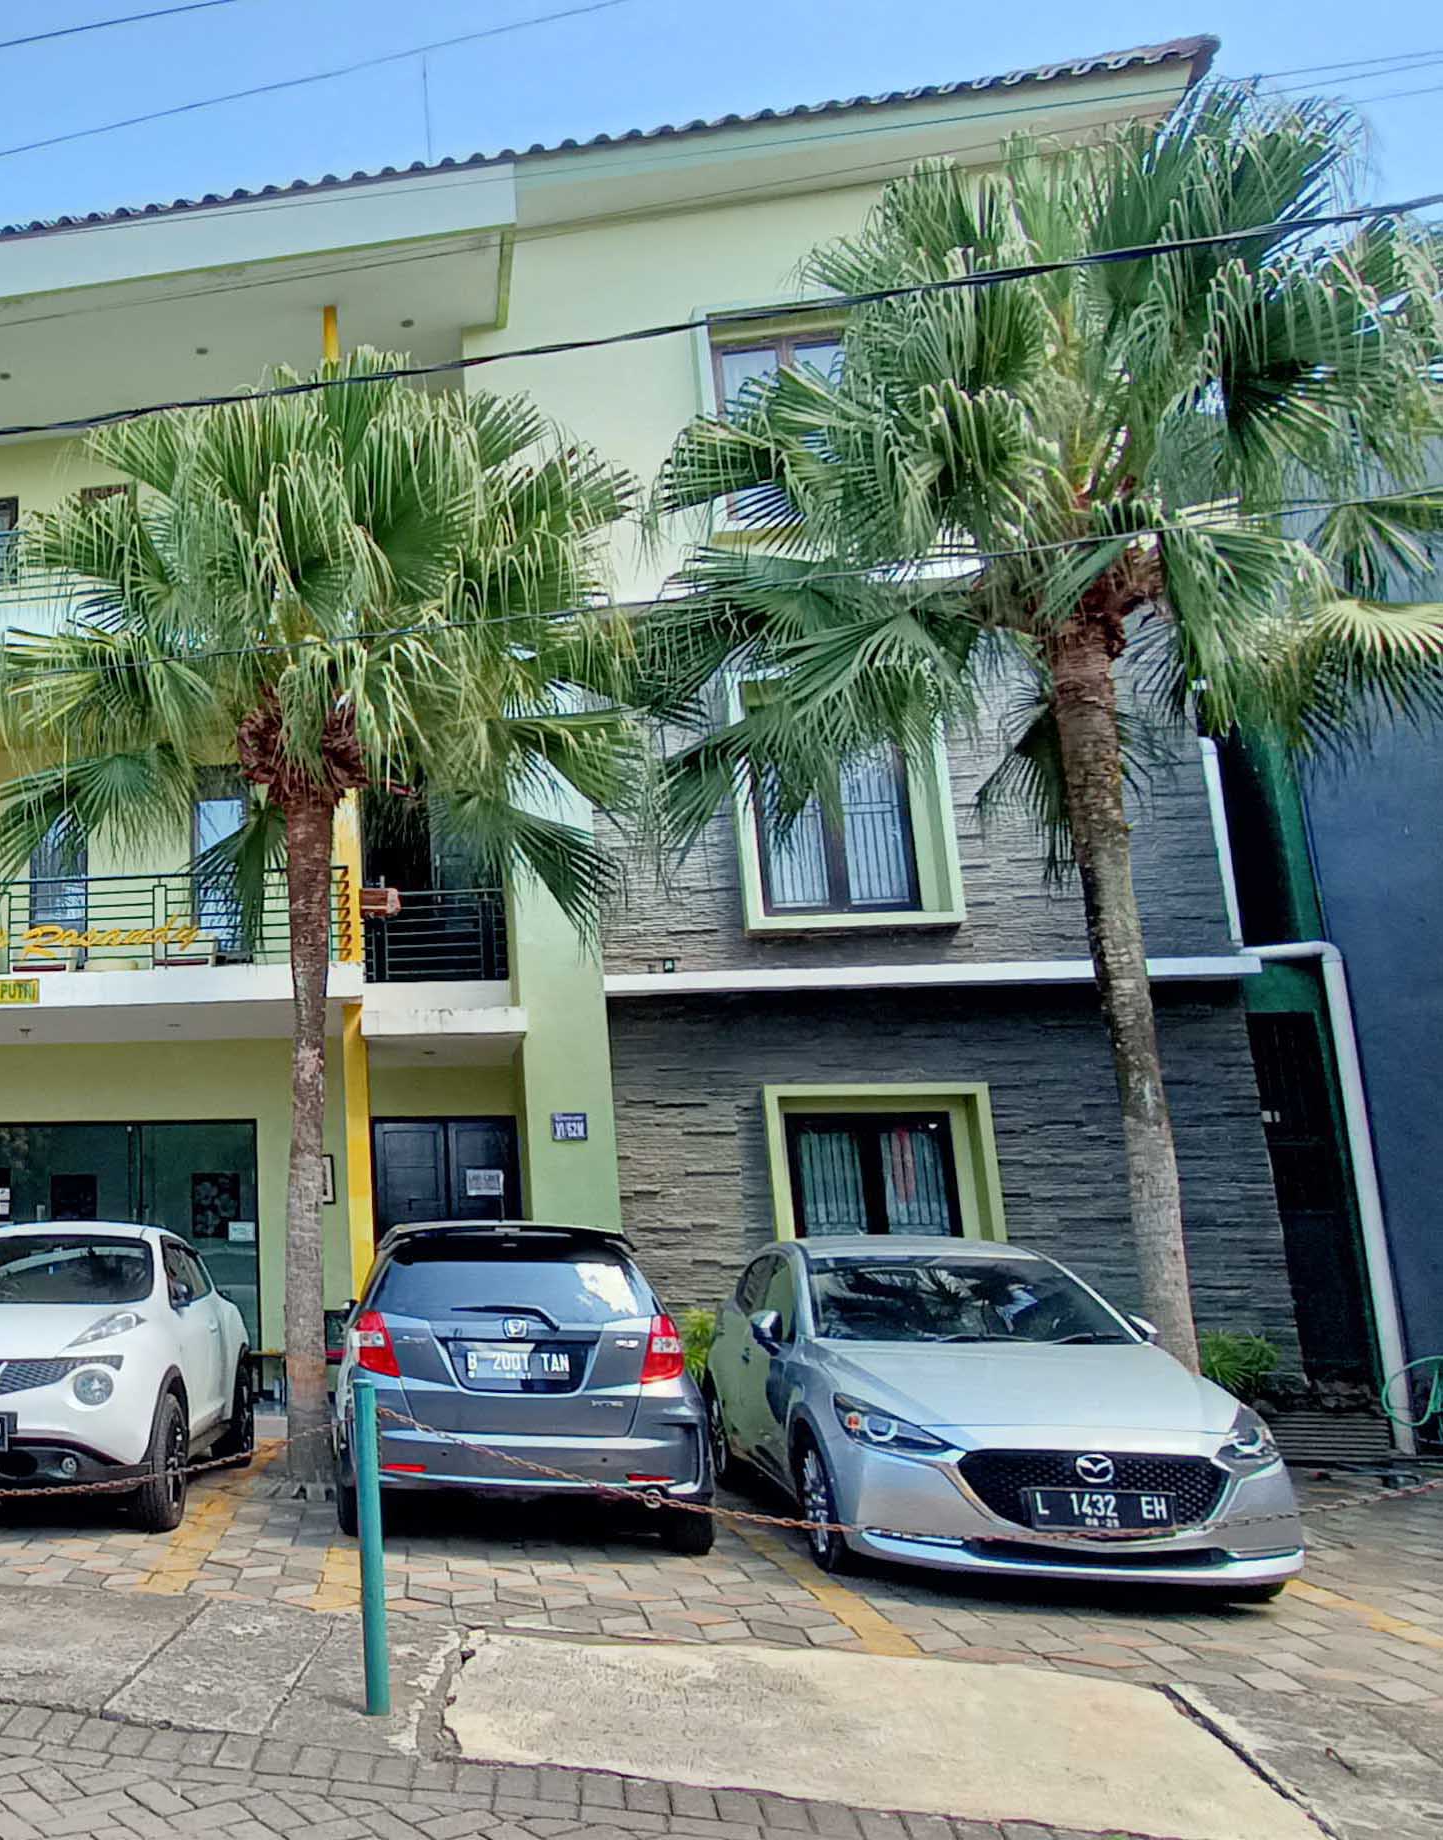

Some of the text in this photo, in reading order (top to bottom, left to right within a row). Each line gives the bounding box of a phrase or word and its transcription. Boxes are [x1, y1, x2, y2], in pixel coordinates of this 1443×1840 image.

[0, 982, 38, 1001] PUTRI
[466, 1351, 478, 1371] B
[540, 1353, 571, 1373] TAN
[1035, 1491, 1168, 1520] L 1432 EH
